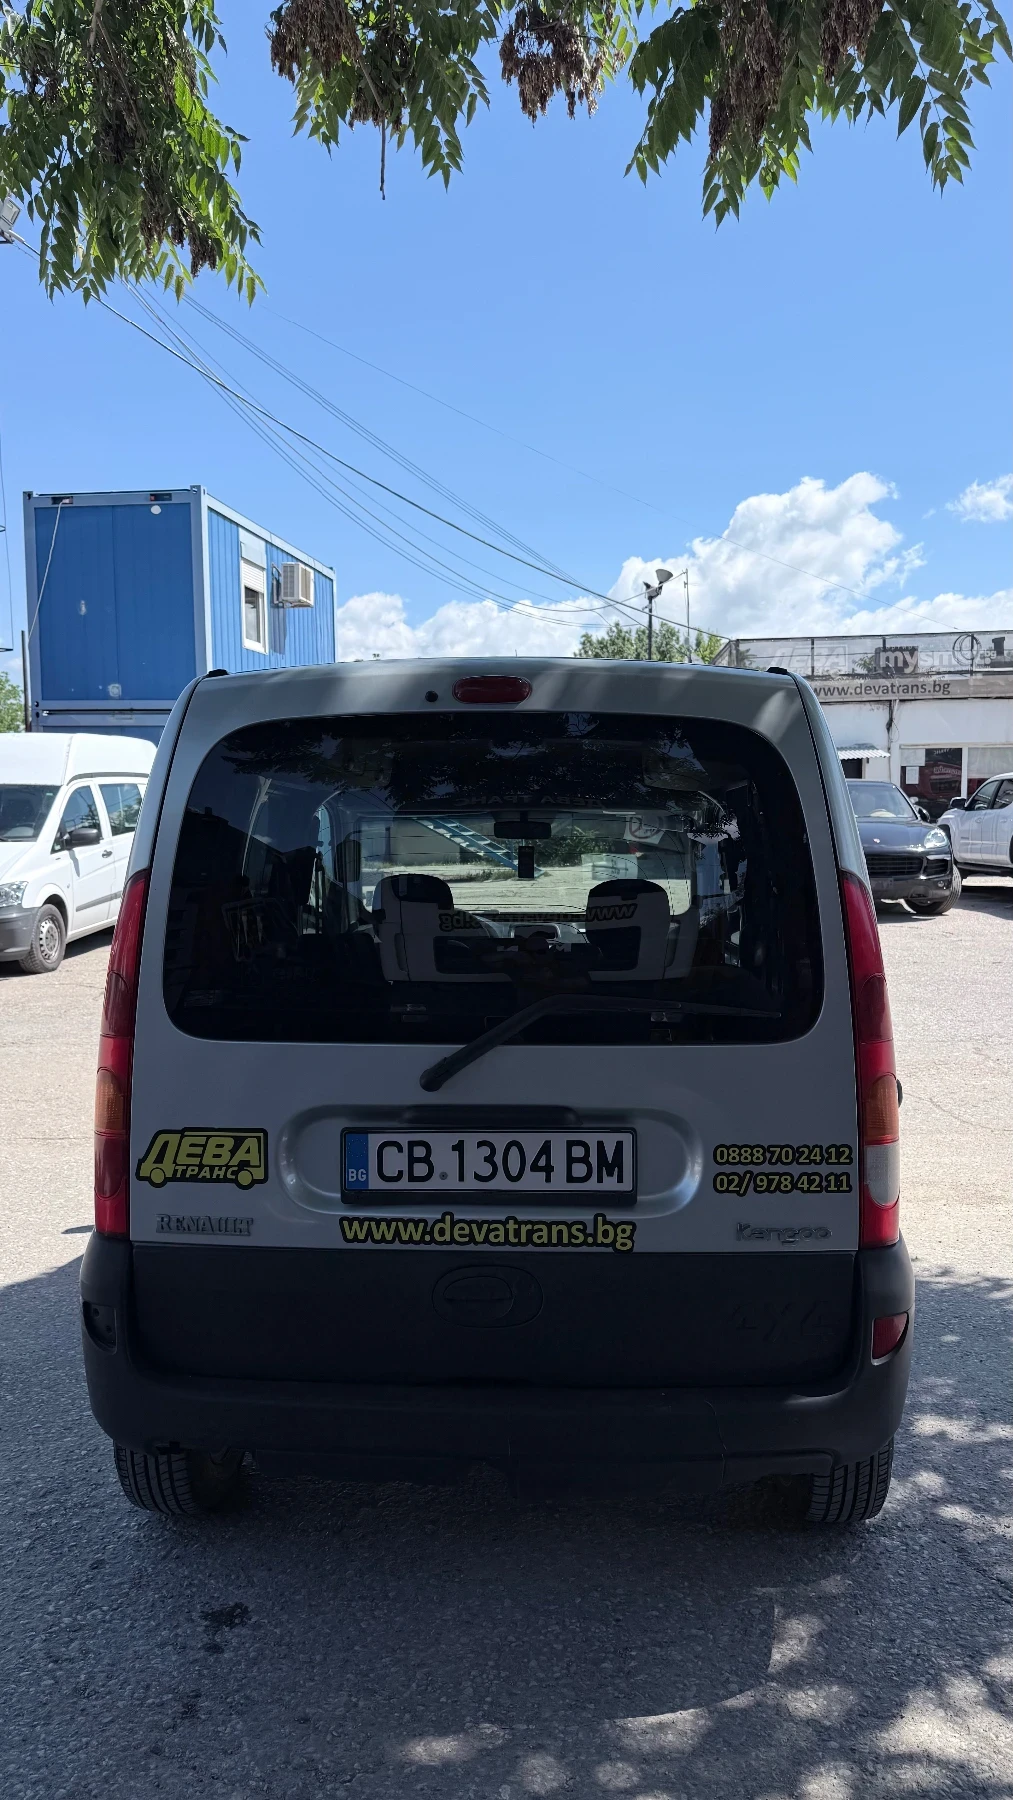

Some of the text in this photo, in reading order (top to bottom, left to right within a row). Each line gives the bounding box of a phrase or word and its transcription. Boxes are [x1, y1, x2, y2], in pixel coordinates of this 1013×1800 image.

[140, 1133, 261, 1173] ДЕВА
[450, 1139, 555, 1184] 1304
[715, 1147, 850, 1163] 0888 70 24 12
[174, 1165, 239, 1180] ТРАНС
[348, 1168, 367, 1182] BG
[756, 1174, 792, 1191] 978
[797, 1174, 821, 1191] 42
[827, 1174, 850, 1191] 11
[156, 1213, 254, 1236] RENAULT
[341, 1214, 633, 1251] www.devatrans.bg
